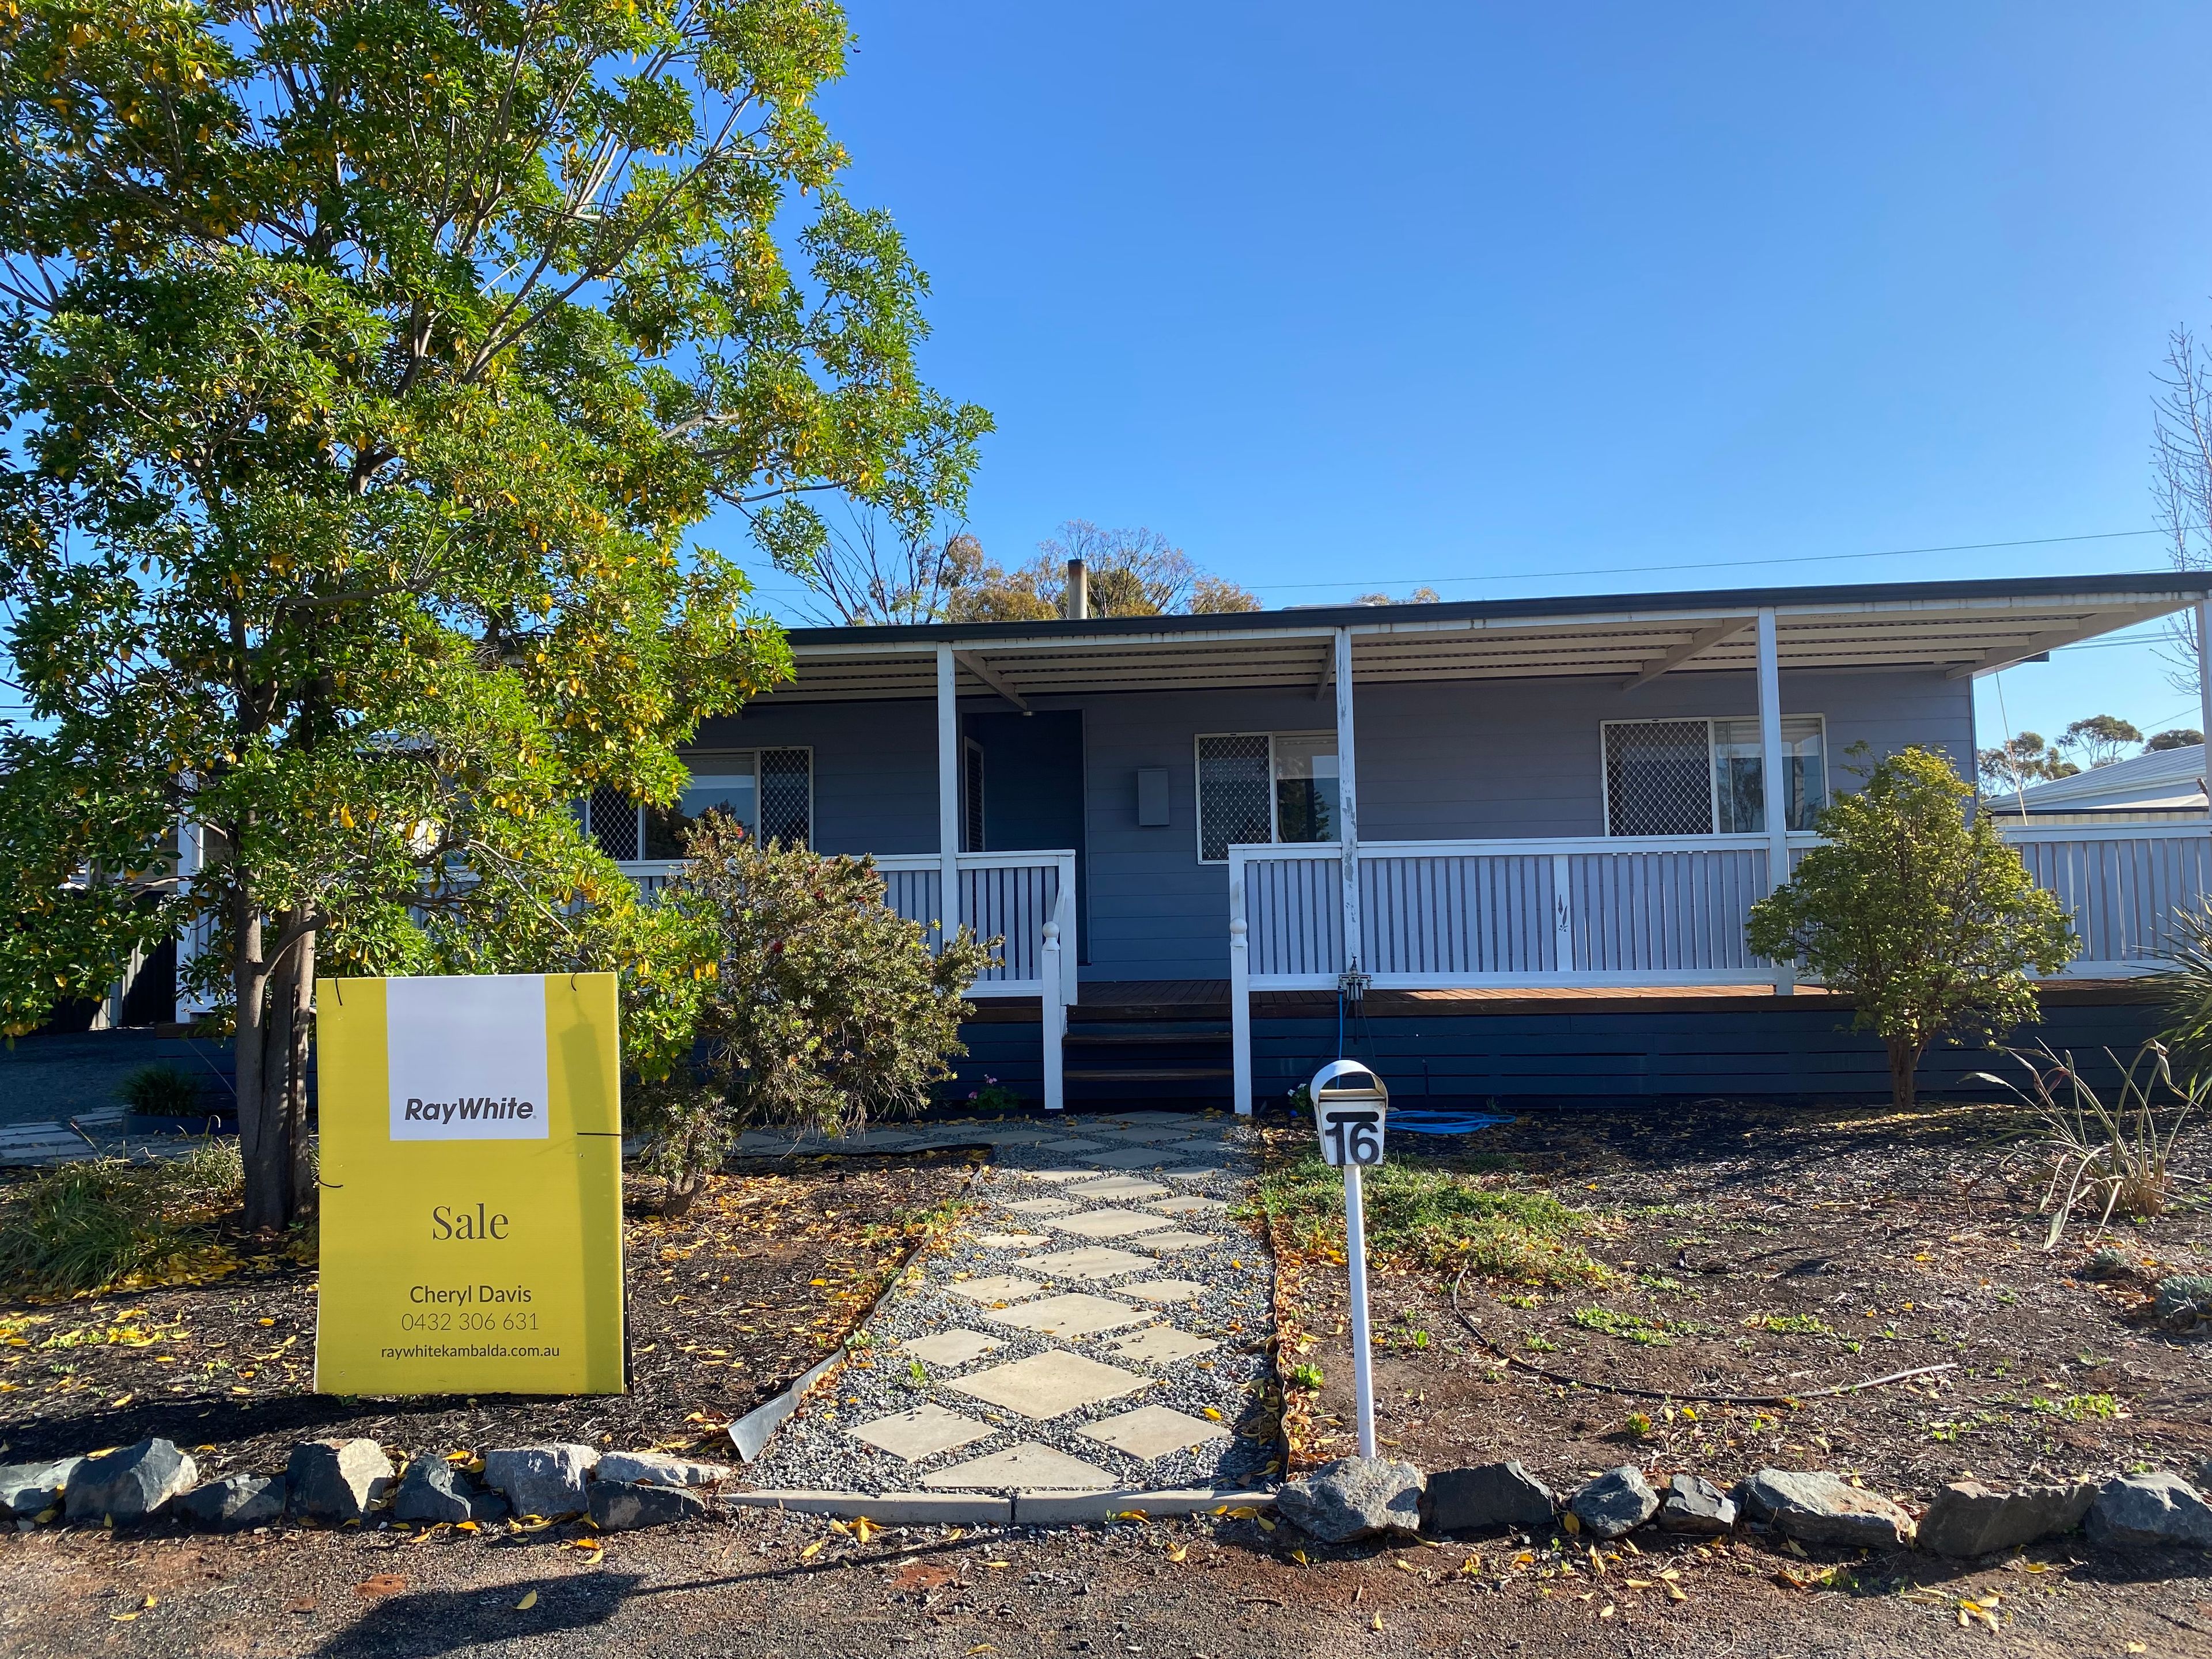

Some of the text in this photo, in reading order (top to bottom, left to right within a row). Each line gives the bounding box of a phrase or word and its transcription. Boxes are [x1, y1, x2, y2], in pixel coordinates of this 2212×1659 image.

[1325, 1122, 1380, 1165] 16
[432, 1203, 509, 1240] Sale
[410, 1285, 532, 1307] Cheryl Davis
[402, 1312, 539, 1331] 0432 306 631
[381, 1343, 559, 1361] raywhitekambalda.com.au
